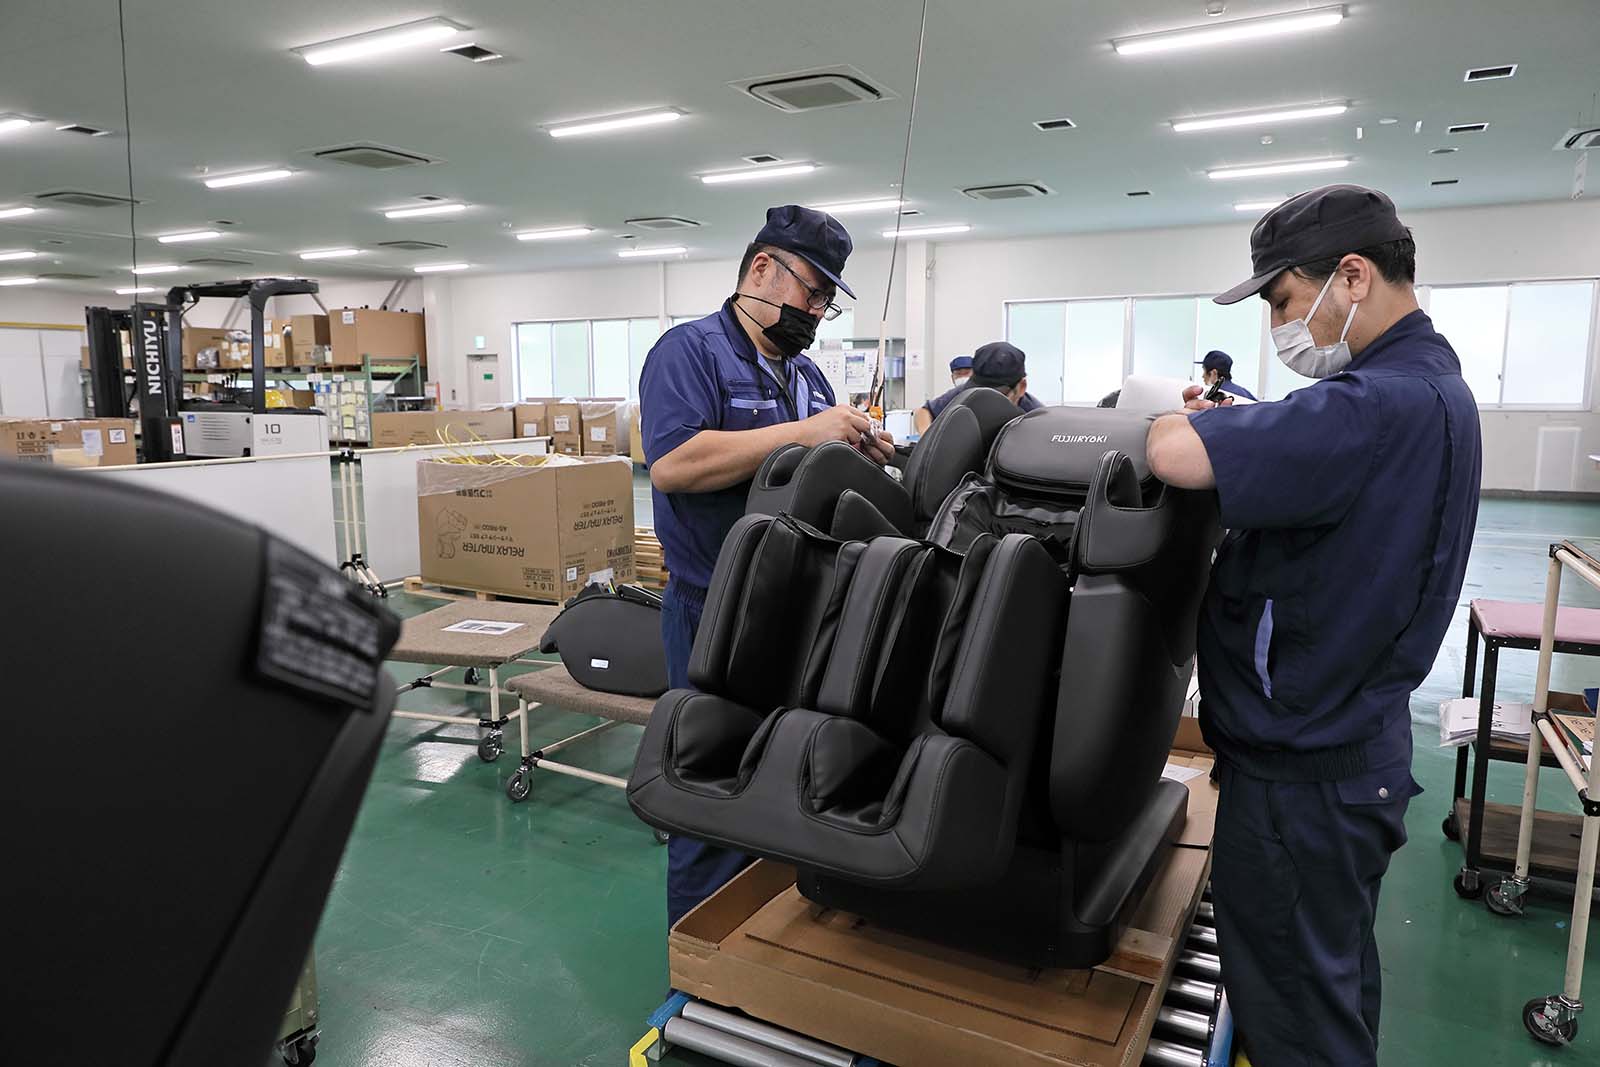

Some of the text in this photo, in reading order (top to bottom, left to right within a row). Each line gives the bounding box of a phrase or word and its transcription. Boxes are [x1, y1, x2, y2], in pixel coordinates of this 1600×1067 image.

[143, 320, 162, 395] NICHIYU
[264, 423, 281, 434] 10
[1050, 434, 1107, 443] FUJIIRYOKI
[462, 542, 525, 558] RELAX MASTER
